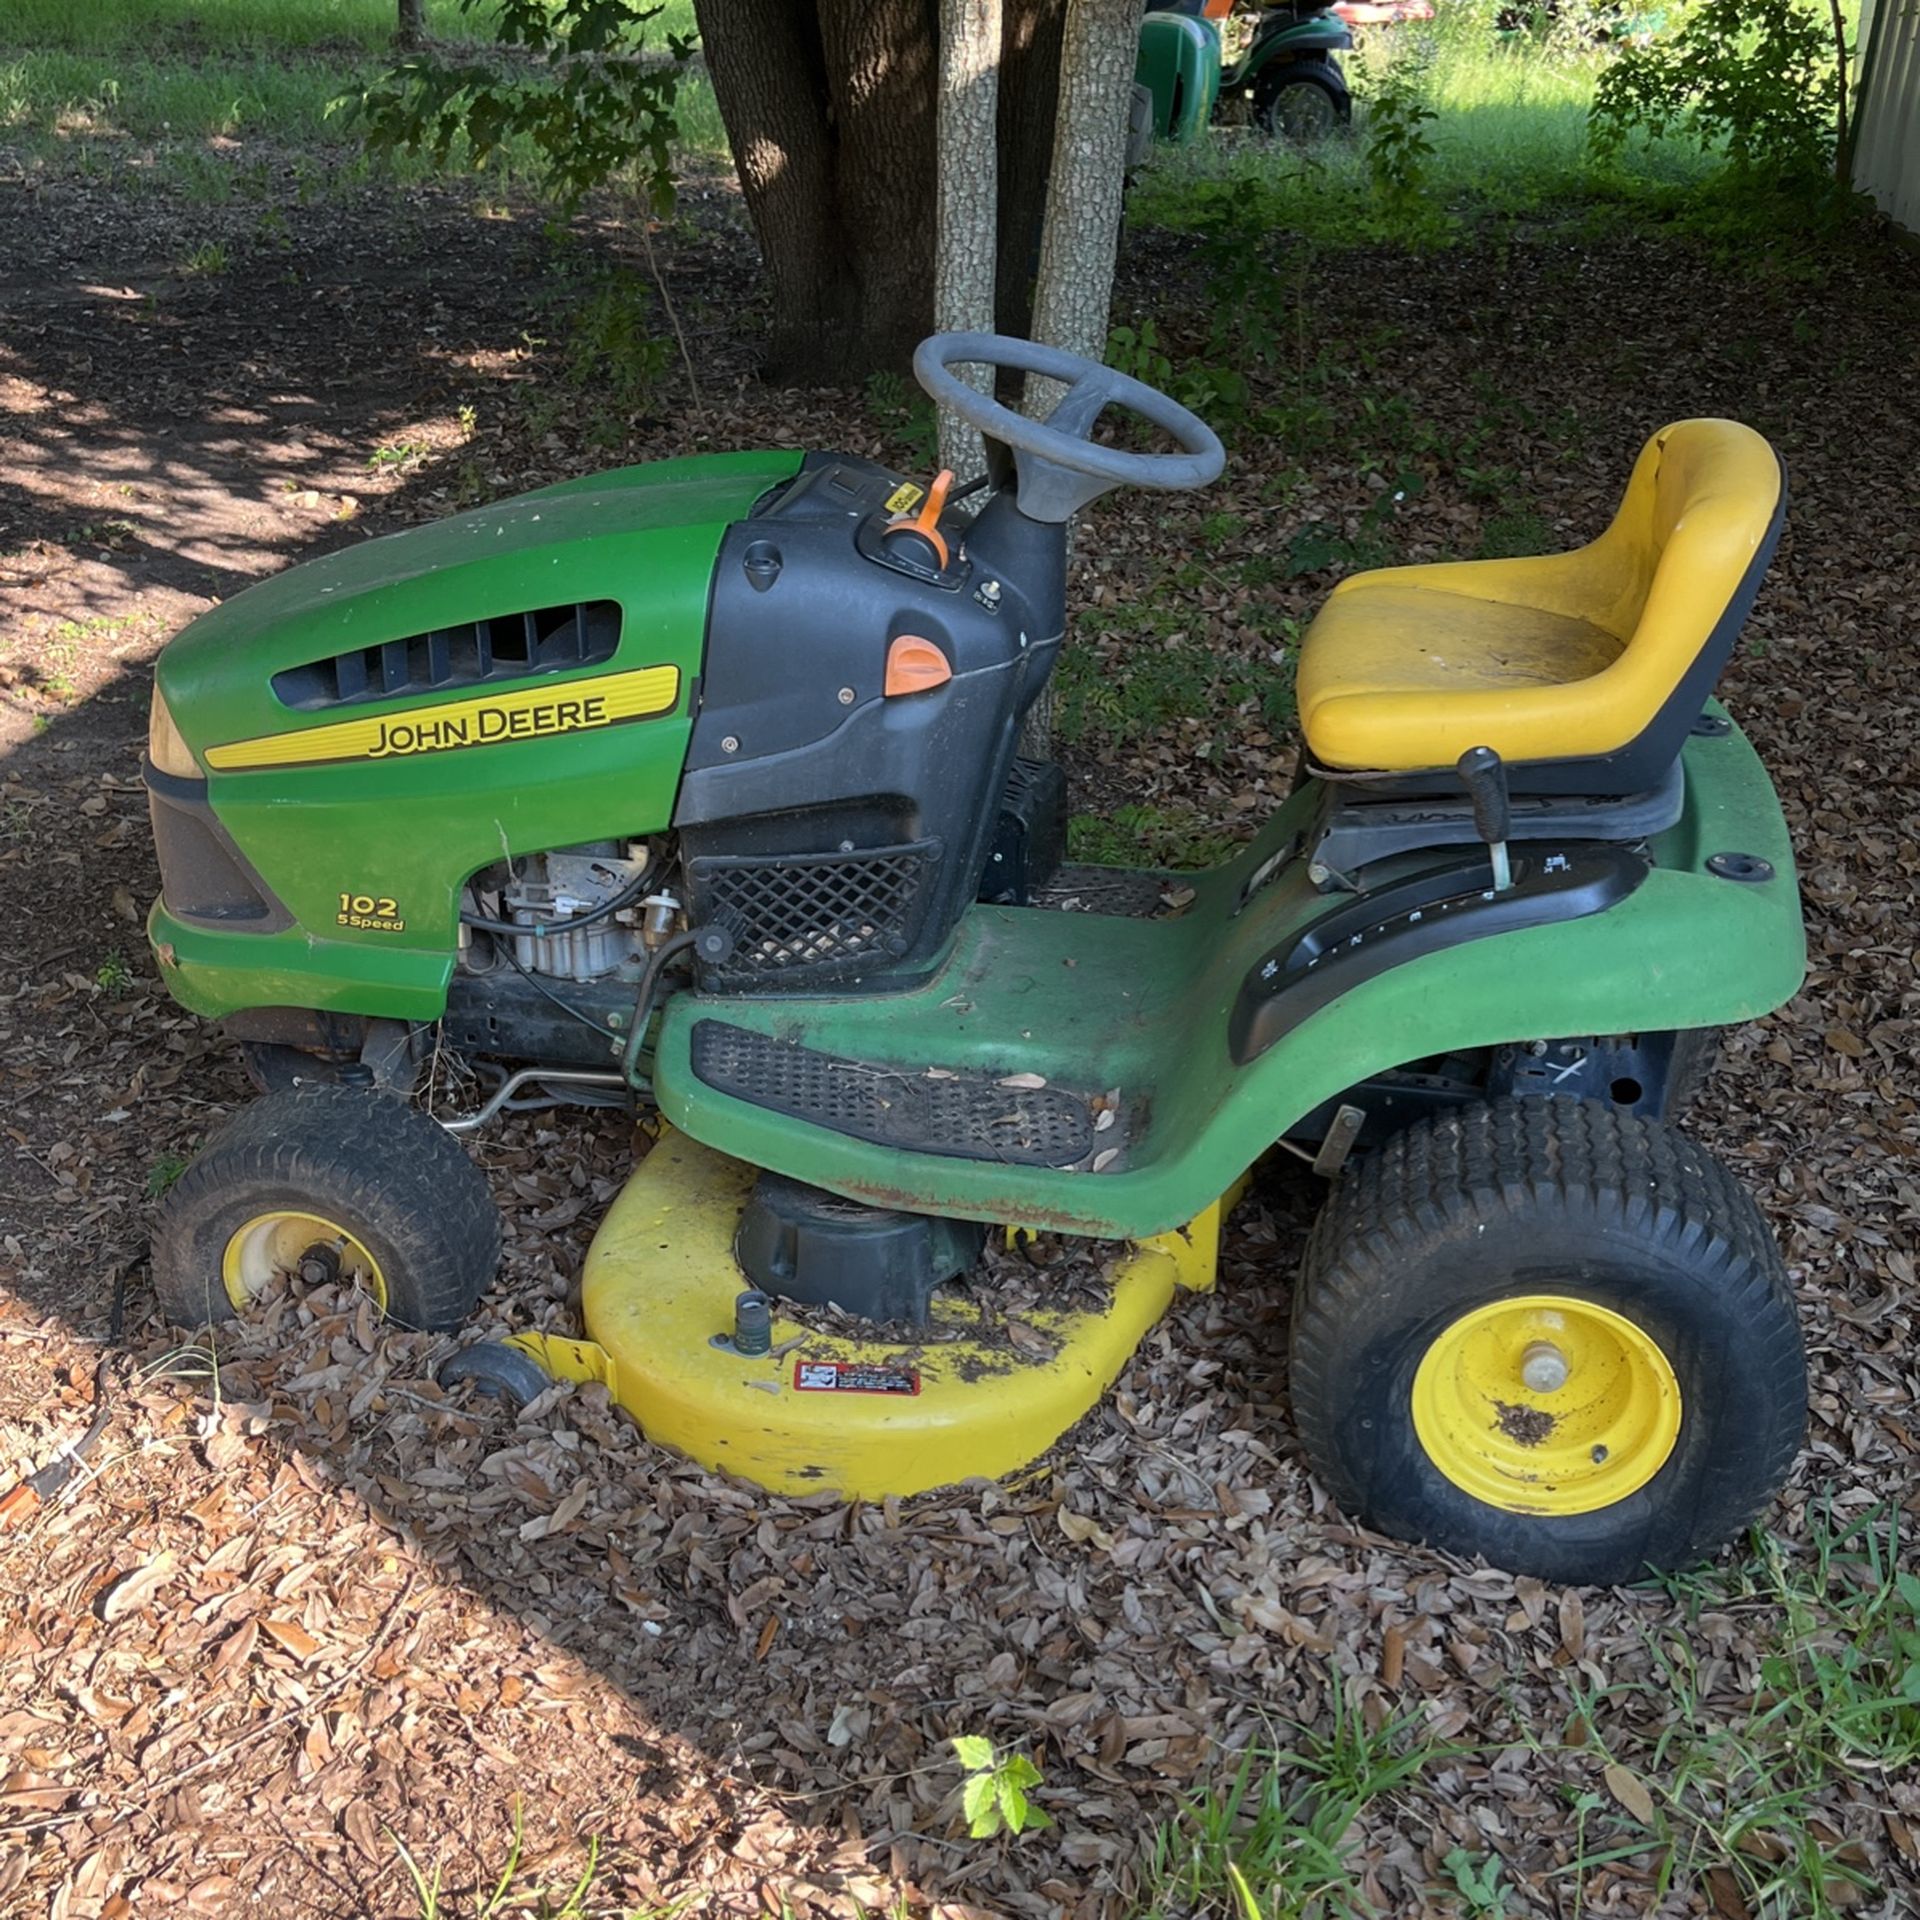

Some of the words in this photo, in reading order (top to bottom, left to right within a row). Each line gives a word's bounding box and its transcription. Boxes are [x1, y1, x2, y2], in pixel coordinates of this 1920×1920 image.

[368, 718, 468, 754] JOHN
[478, 697, 606, 740] DEERE
[340, 893, 398, 917] 102
[337, 914, 349, 925] 5
[350, 915, 404, 931] Speed
